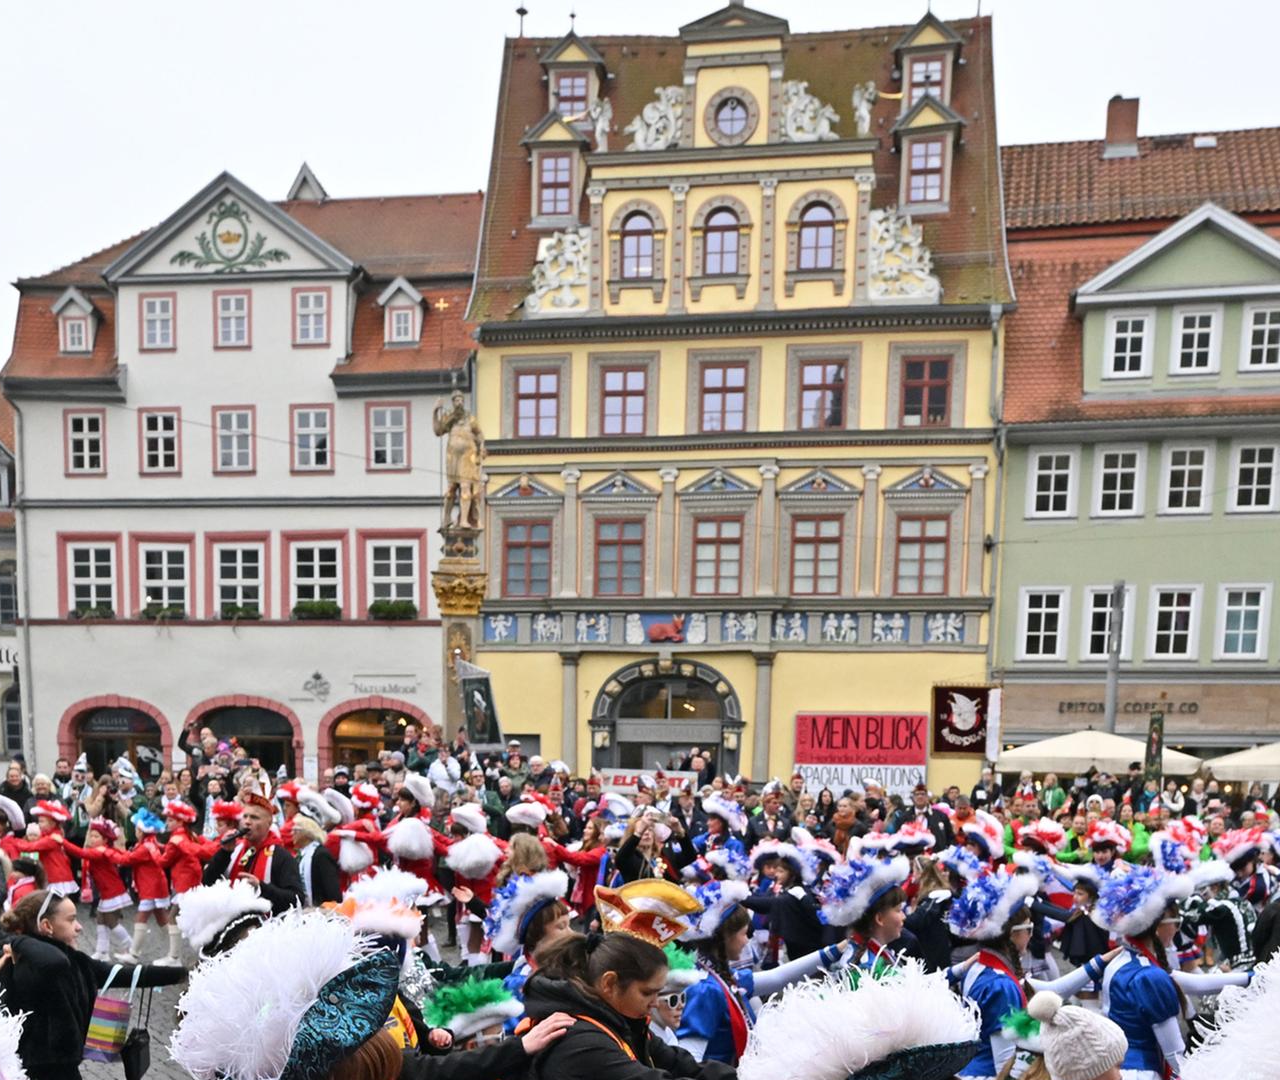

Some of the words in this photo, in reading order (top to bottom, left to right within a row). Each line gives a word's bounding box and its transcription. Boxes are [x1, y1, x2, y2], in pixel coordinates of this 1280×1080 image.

[810, 716, 861, 750] MEIN
[864, 716, 924, 750] BLICK
[850, 766, 921, 787] NOTATIONS
